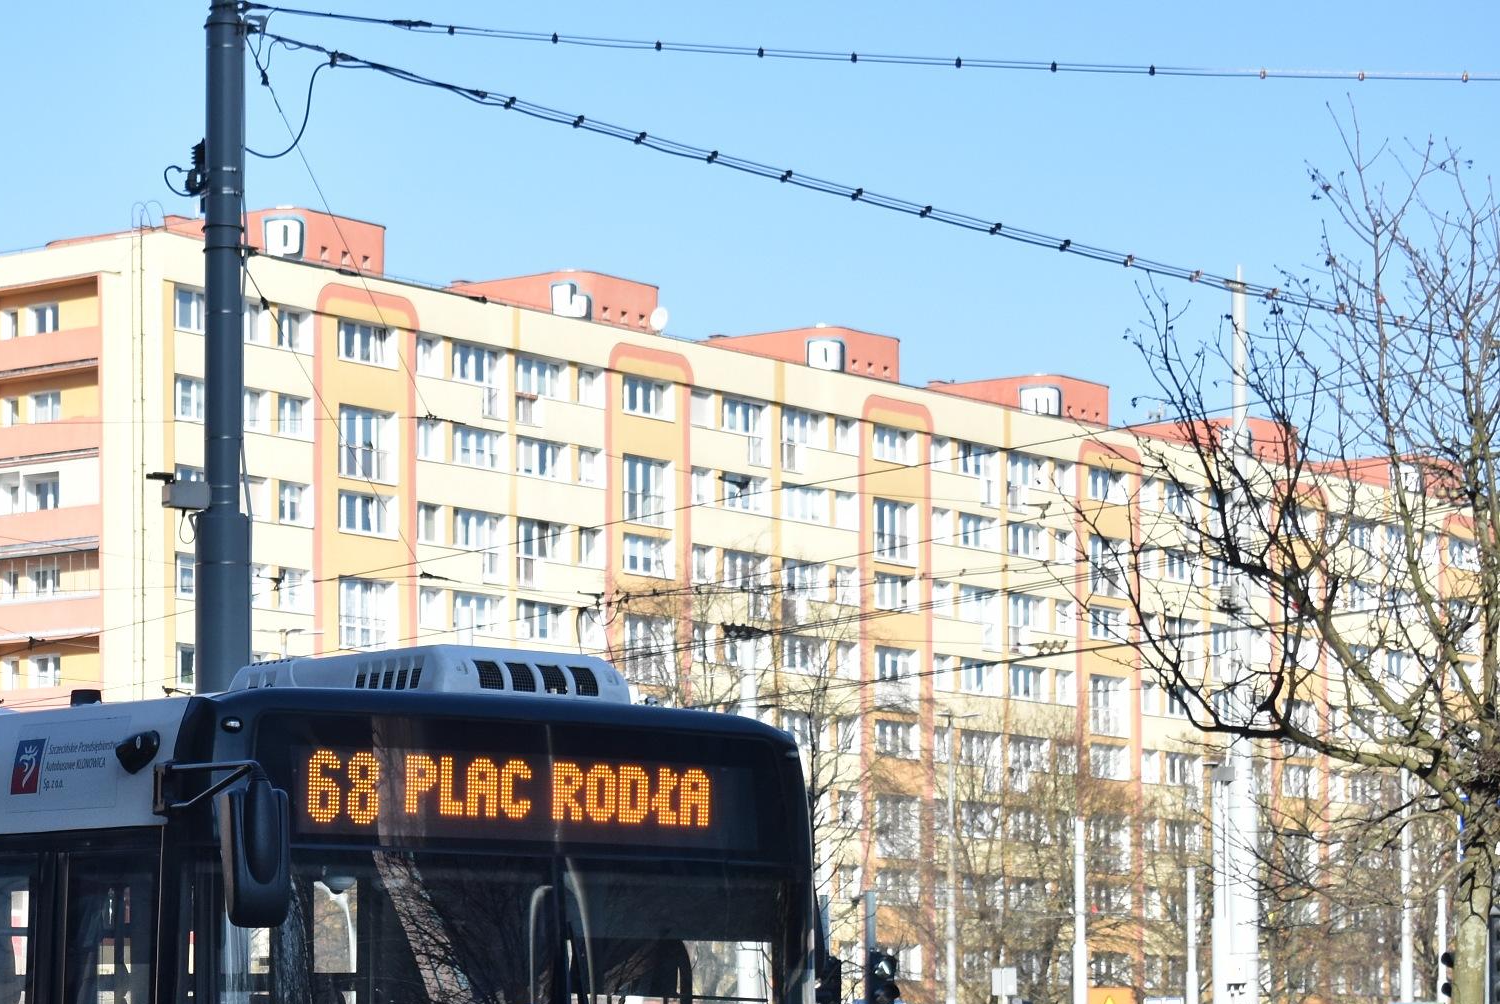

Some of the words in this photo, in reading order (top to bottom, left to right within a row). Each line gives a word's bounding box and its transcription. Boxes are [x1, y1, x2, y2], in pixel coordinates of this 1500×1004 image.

[307, 750, 380, 824] 68
[405, 755, 532, 818] PLAC
[552, 762, 710, 826] RODŁA
